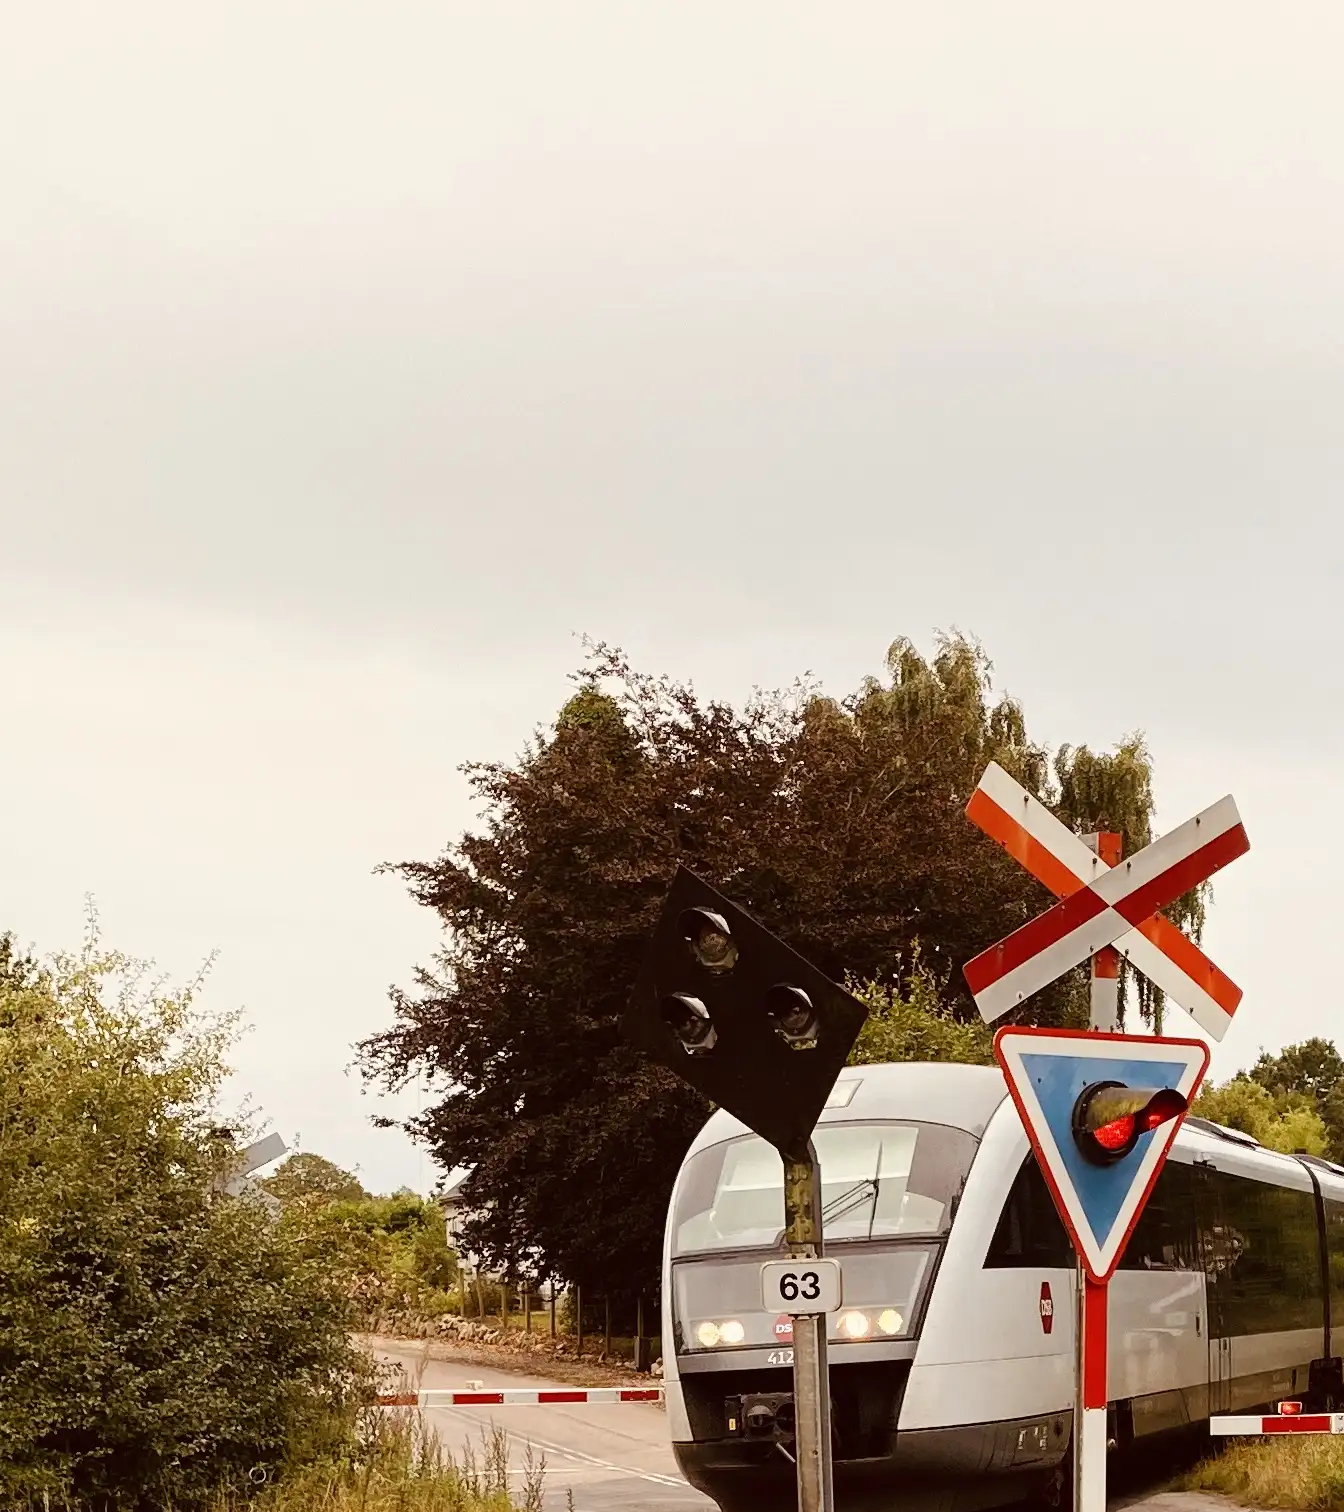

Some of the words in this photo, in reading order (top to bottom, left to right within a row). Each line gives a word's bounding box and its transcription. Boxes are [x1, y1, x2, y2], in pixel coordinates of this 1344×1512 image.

[779, 1271, 821, 1301] 63
[775, 1323, 793, 1334] DS
[767, 1350, 794, 1365] 412
